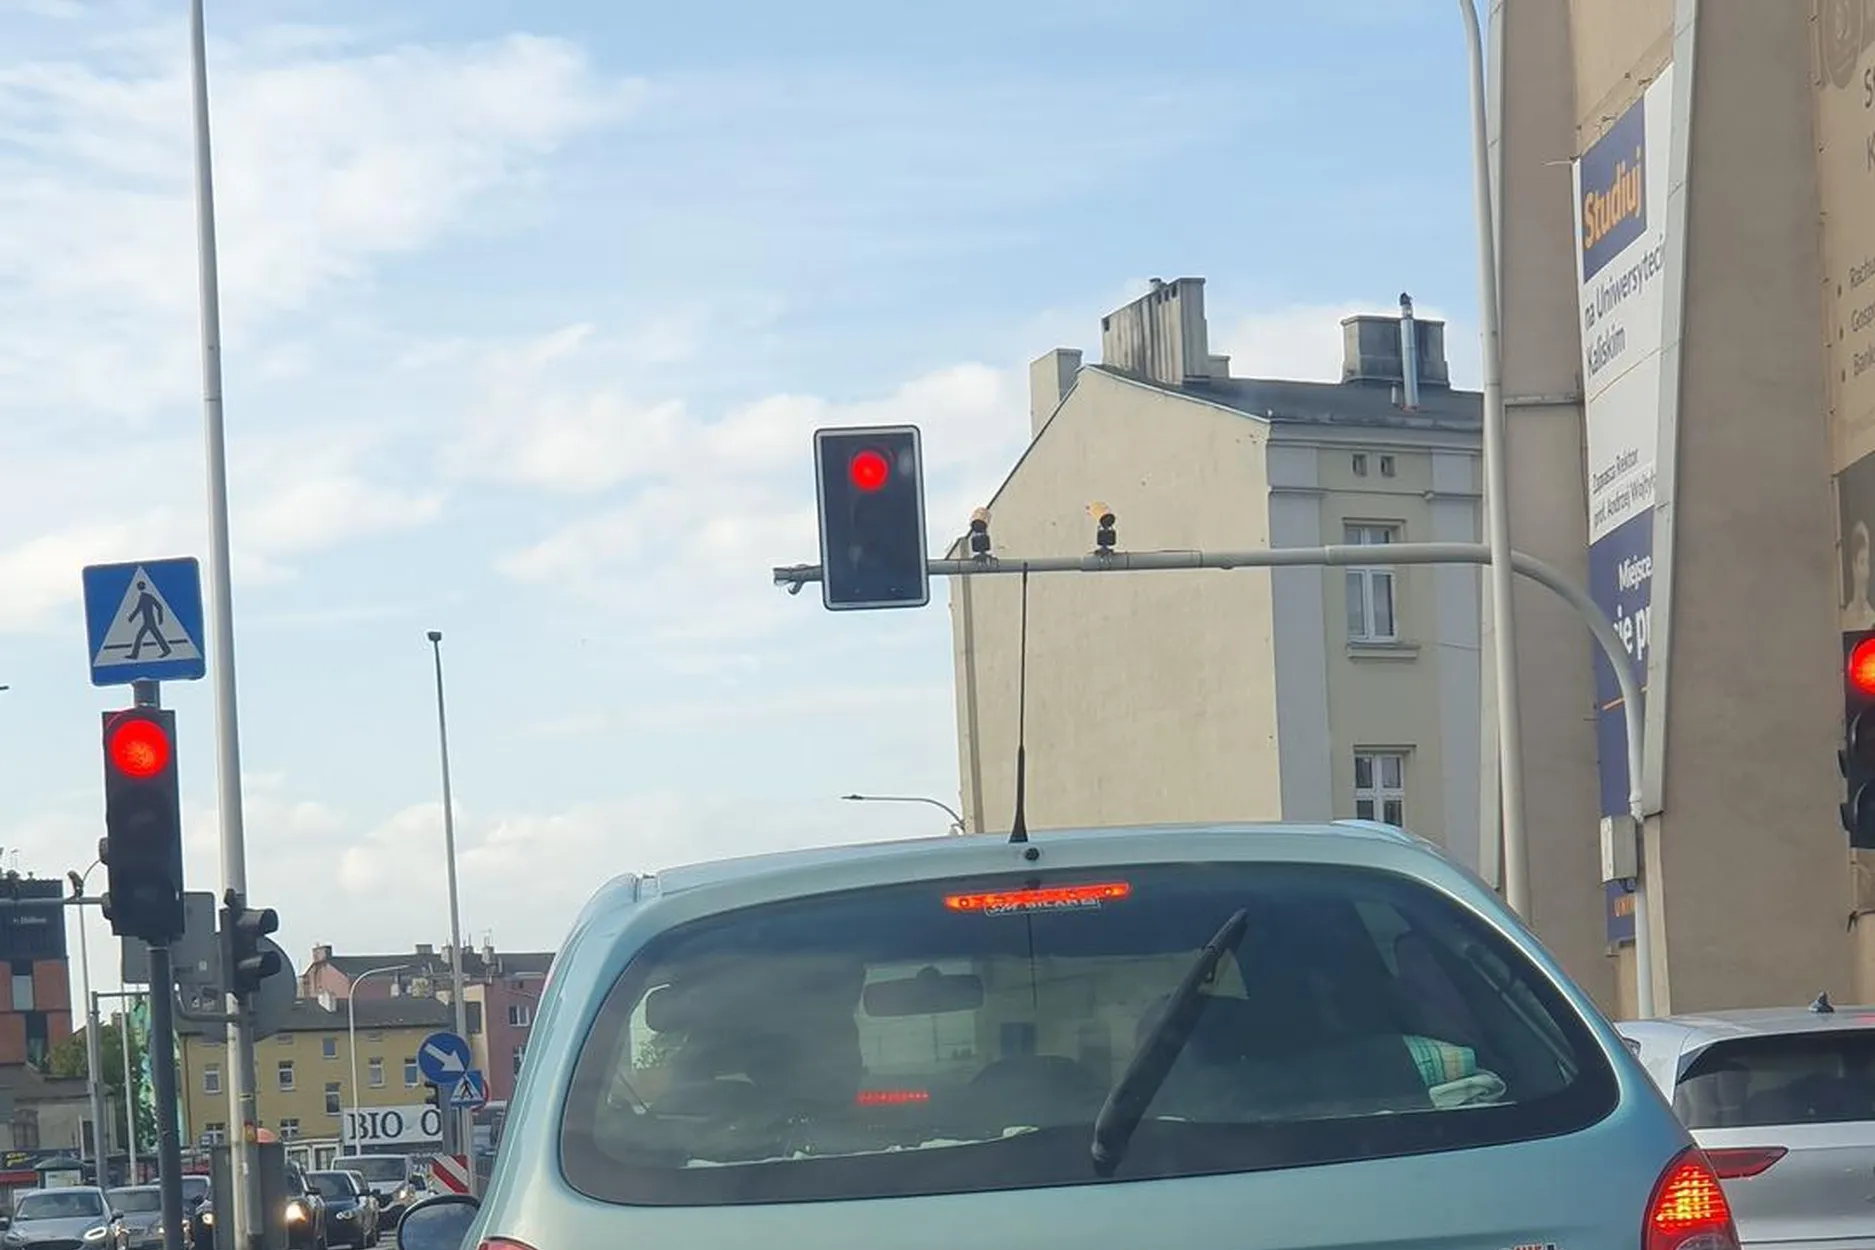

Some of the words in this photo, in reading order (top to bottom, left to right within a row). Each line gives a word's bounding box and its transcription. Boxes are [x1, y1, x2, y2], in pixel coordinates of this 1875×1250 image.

[1583, 145, 1642, 249] Studiuj
[1595, 232, 1665, 319] Uniwersyteci
[1612, 604, 1633, 654] ie
[347, 1110, 404, 1140] BIO
